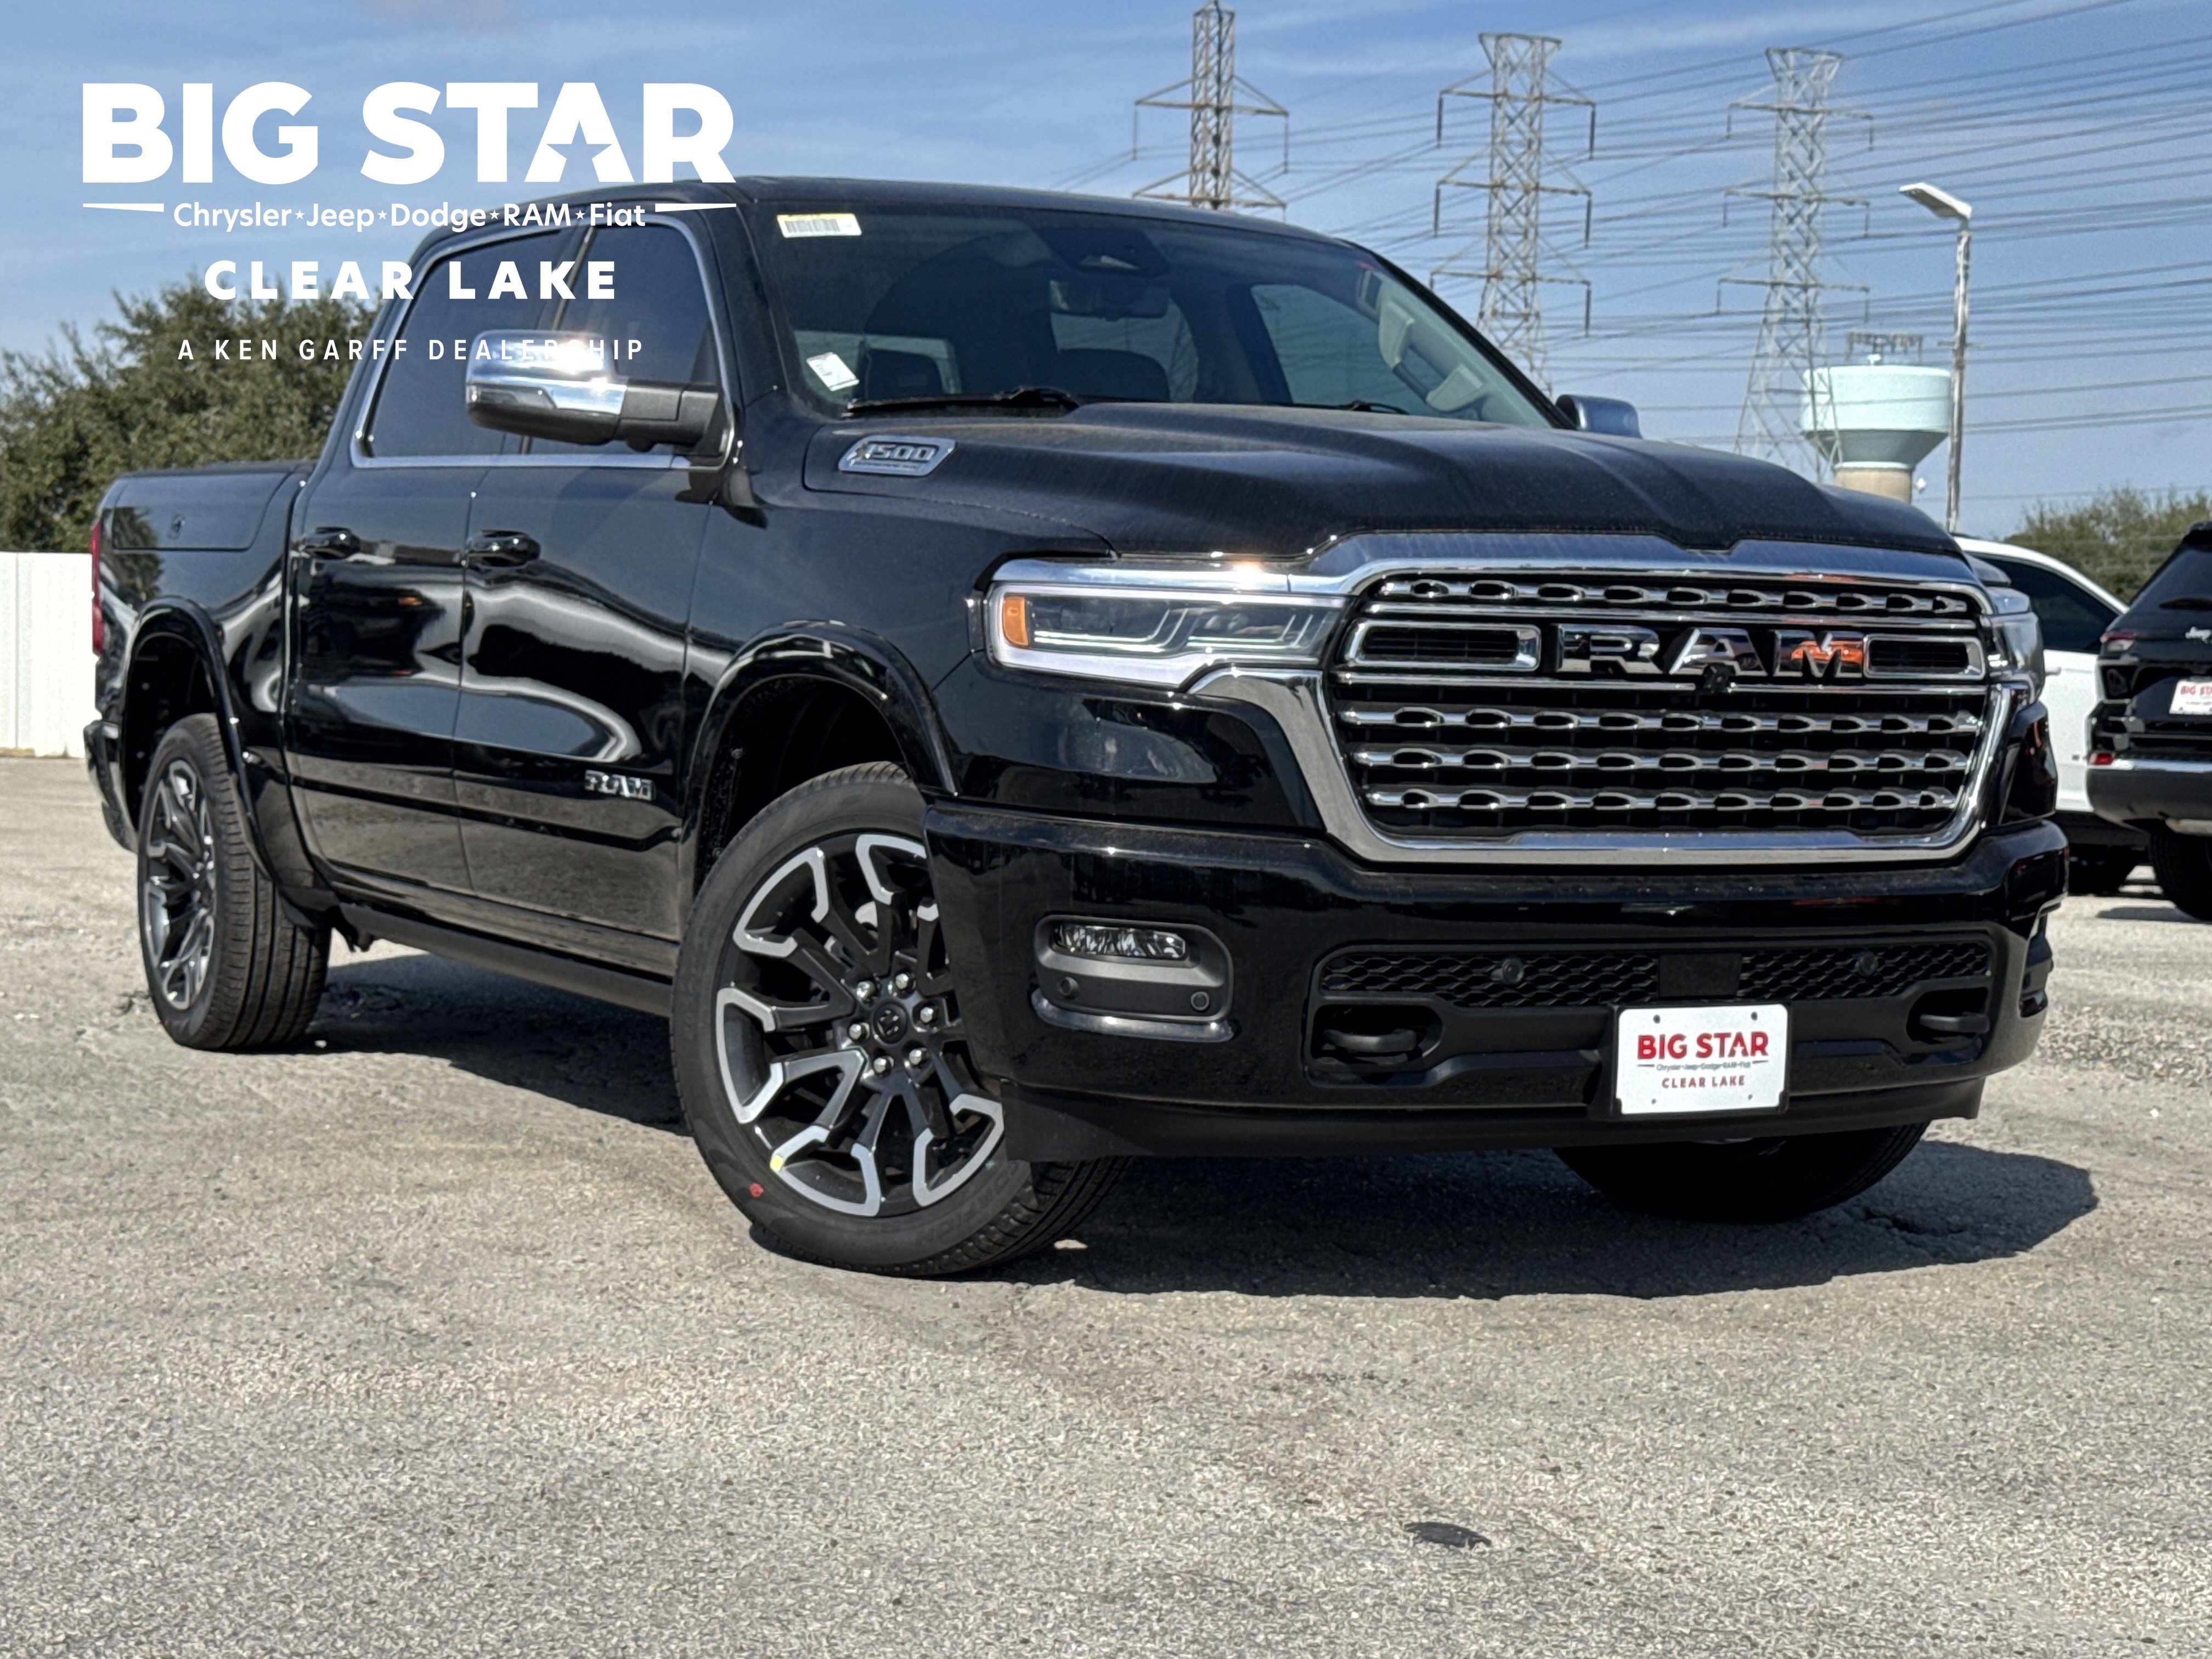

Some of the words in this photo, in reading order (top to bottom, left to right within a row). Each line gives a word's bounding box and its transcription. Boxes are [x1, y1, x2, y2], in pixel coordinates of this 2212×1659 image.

[864, 443, 936, 461] 1500
[1550, 623, 1864, 679] RAM
[584, 769, 657, 802] RAM
[1638, 1033, 1688, 1060] BIG
[1695, 1031, 1769, 1059] STAR
[1661, 1076, 1706, 1089] CLEAR
[1712, 1074, 1746, 1088] LAKE
